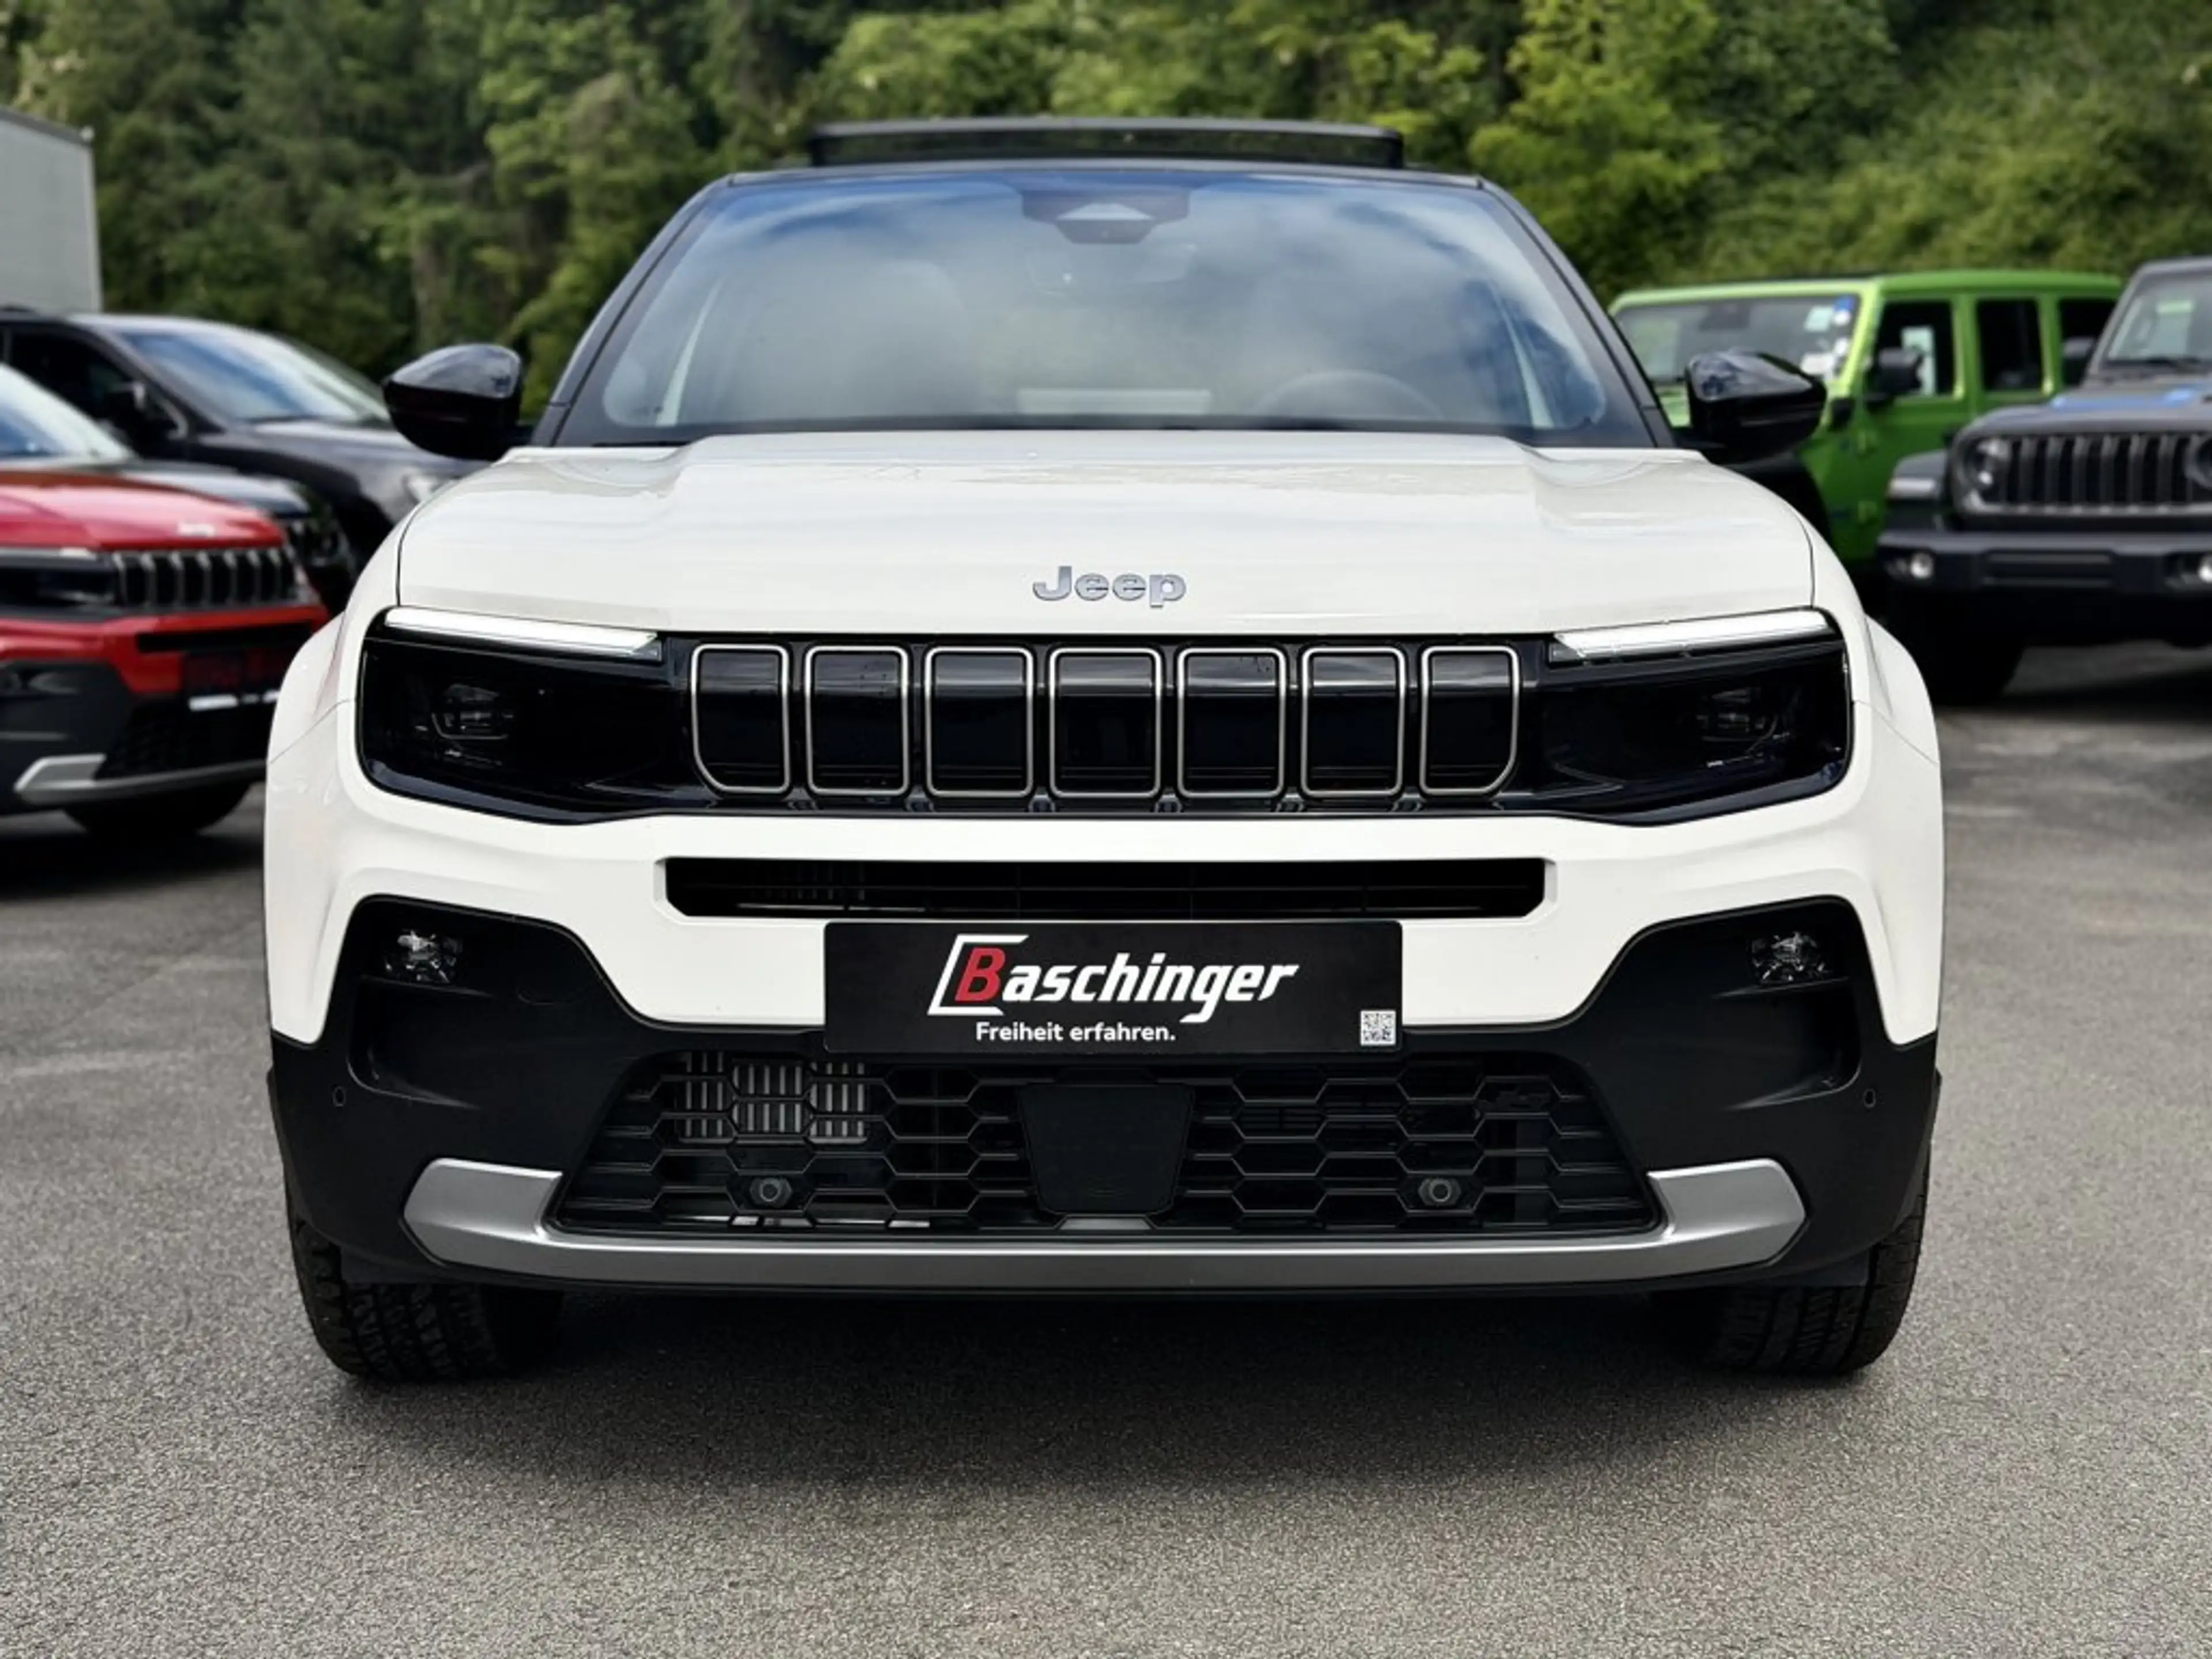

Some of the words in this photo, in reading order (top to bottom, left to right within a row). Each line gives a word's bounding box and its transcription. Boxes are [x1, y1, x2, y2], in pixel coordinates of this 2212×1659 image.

[1033, 565, 1187, 608] Jeep
[955, 946, 1299, 1023] Baschinger
[976, 1022, 1063, 1041] Freiheit
[1070, 1021, 1176, 1041] erfahren.
